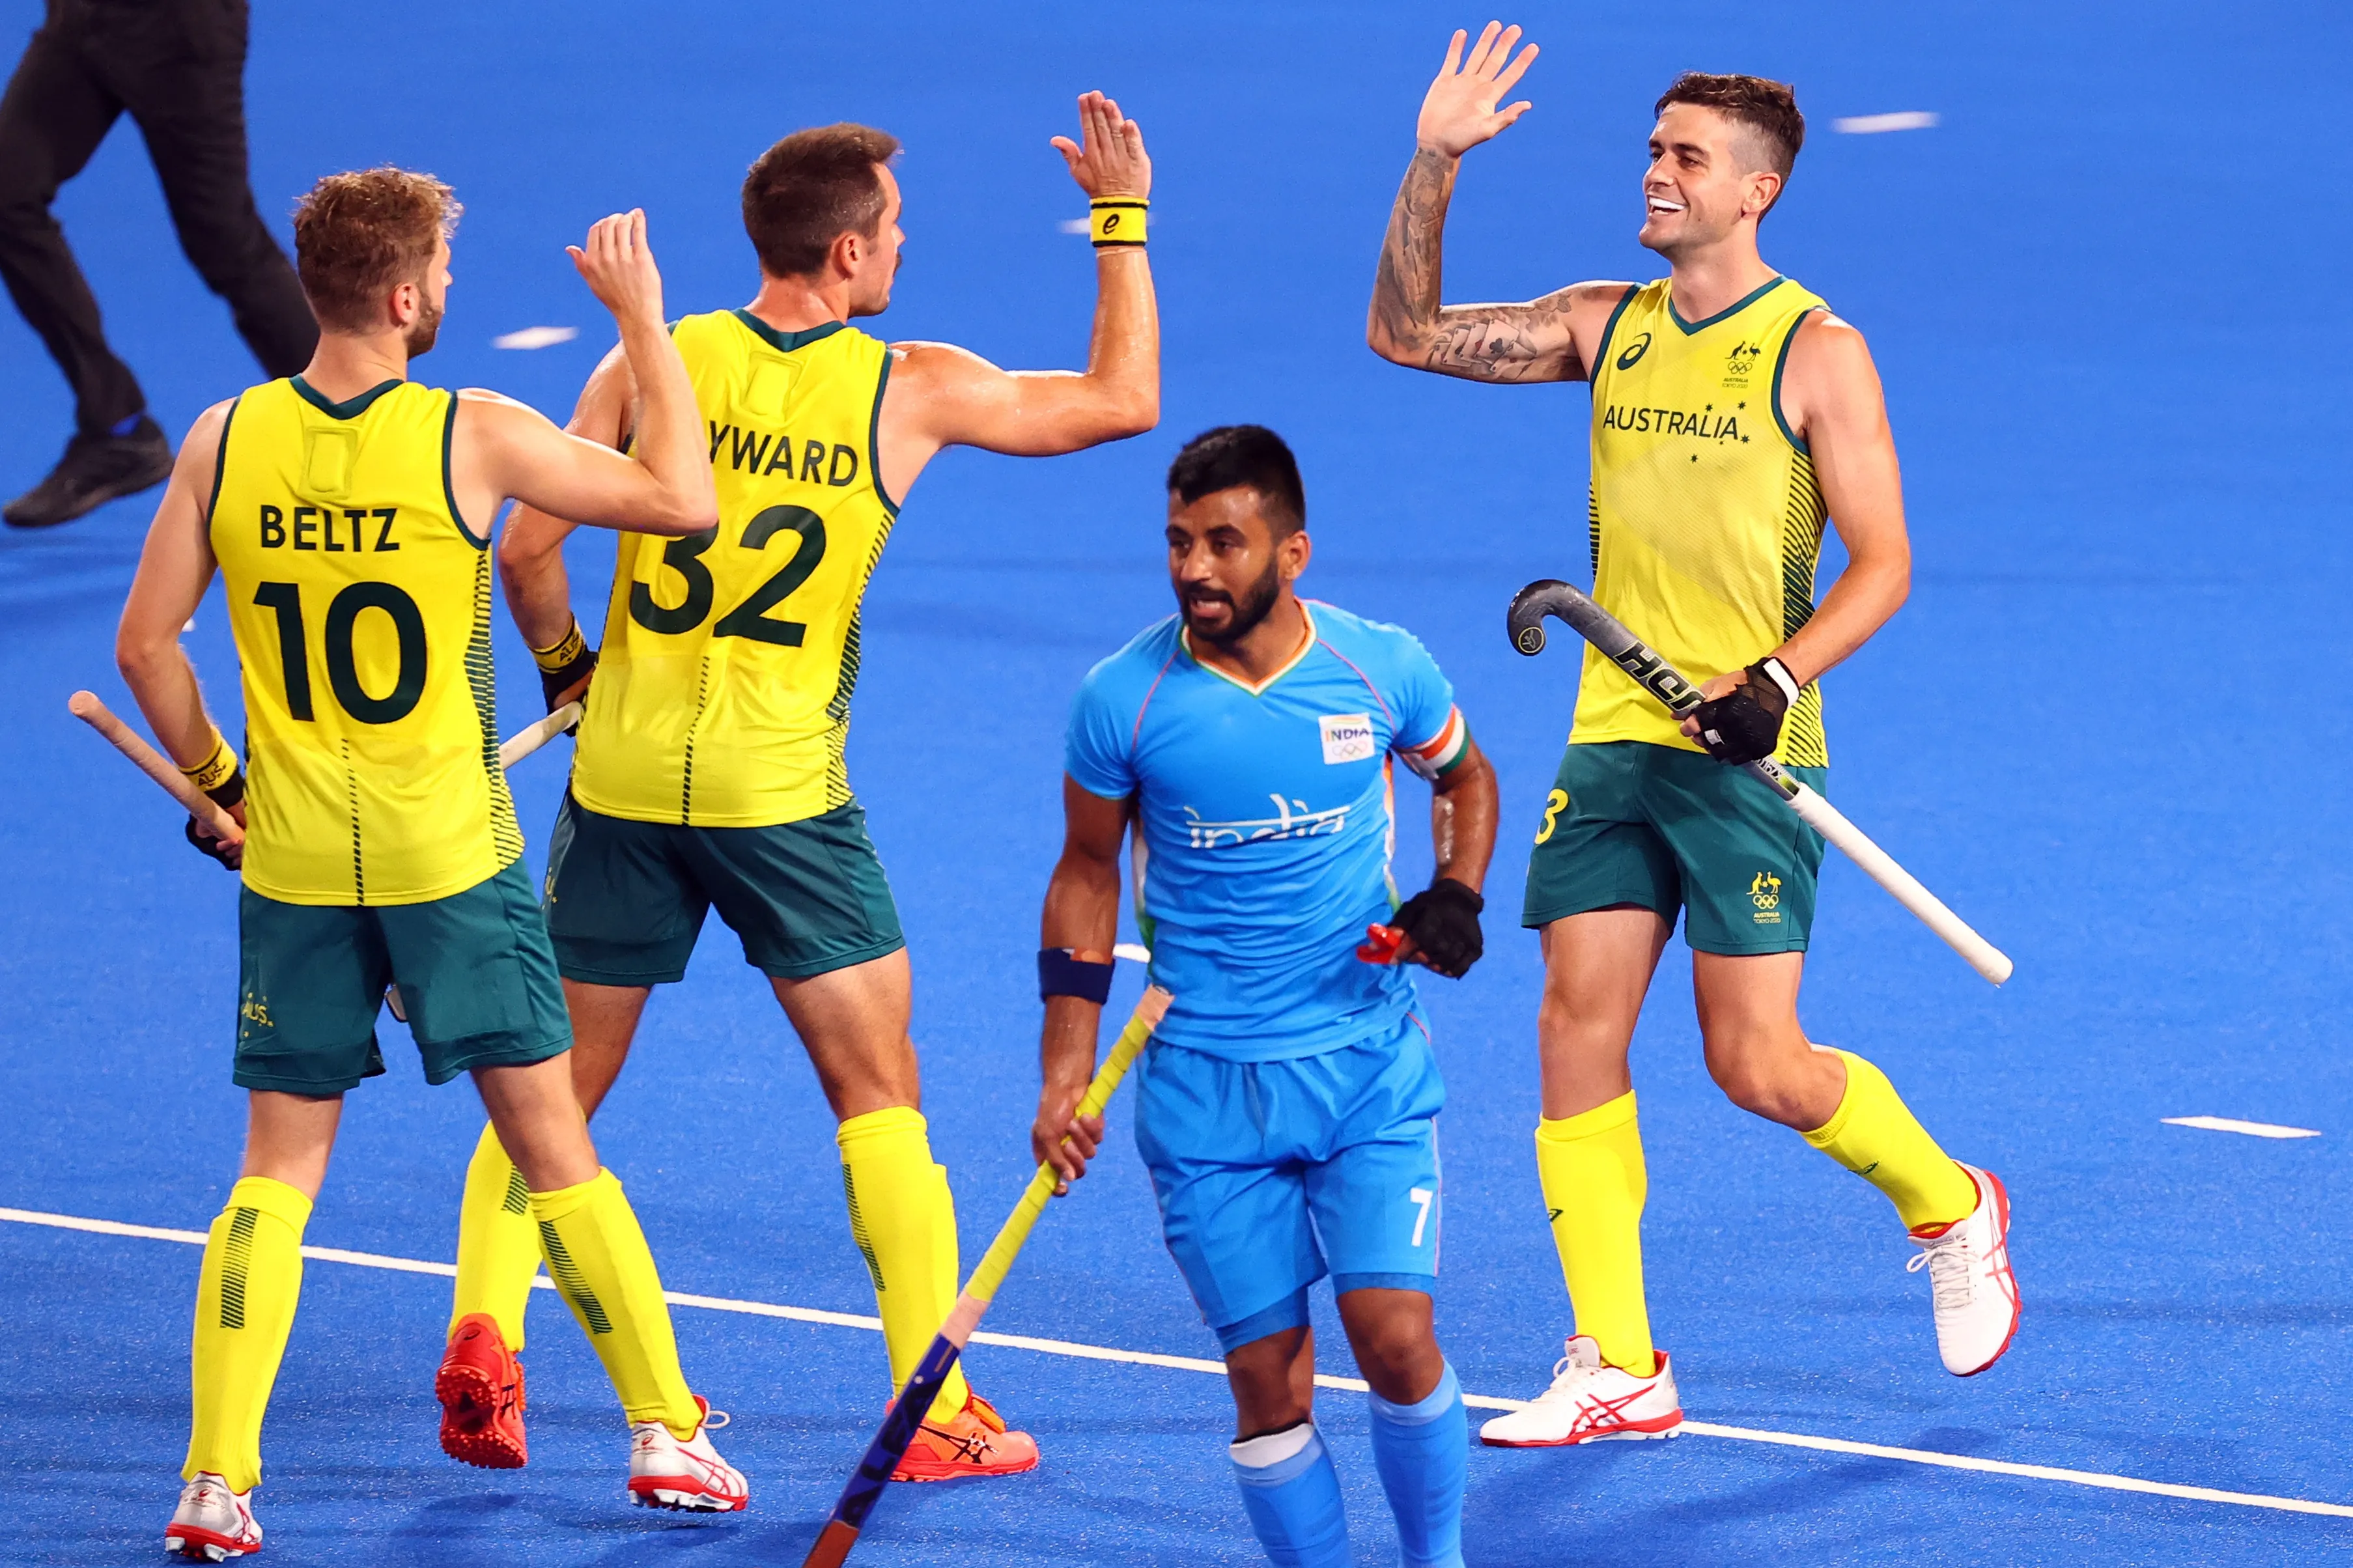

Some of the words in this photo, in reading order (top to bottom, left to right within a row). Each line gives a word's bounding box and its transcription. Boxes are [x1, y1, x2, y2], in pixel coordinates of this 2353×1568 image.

[1603, 405, 1739, 441] AUSTRALIA
[261, 504, 400, 553] BELTZ
[628, 503, 826, 648] 32
[253, 581, 427, 725] 10
[1325, 727, 1370, 743] INDIA
[1183, 793, 1351, 848] india
[1534, 788, 1569, 845] 3
[1409, 1186, 1433, 1248] 7
